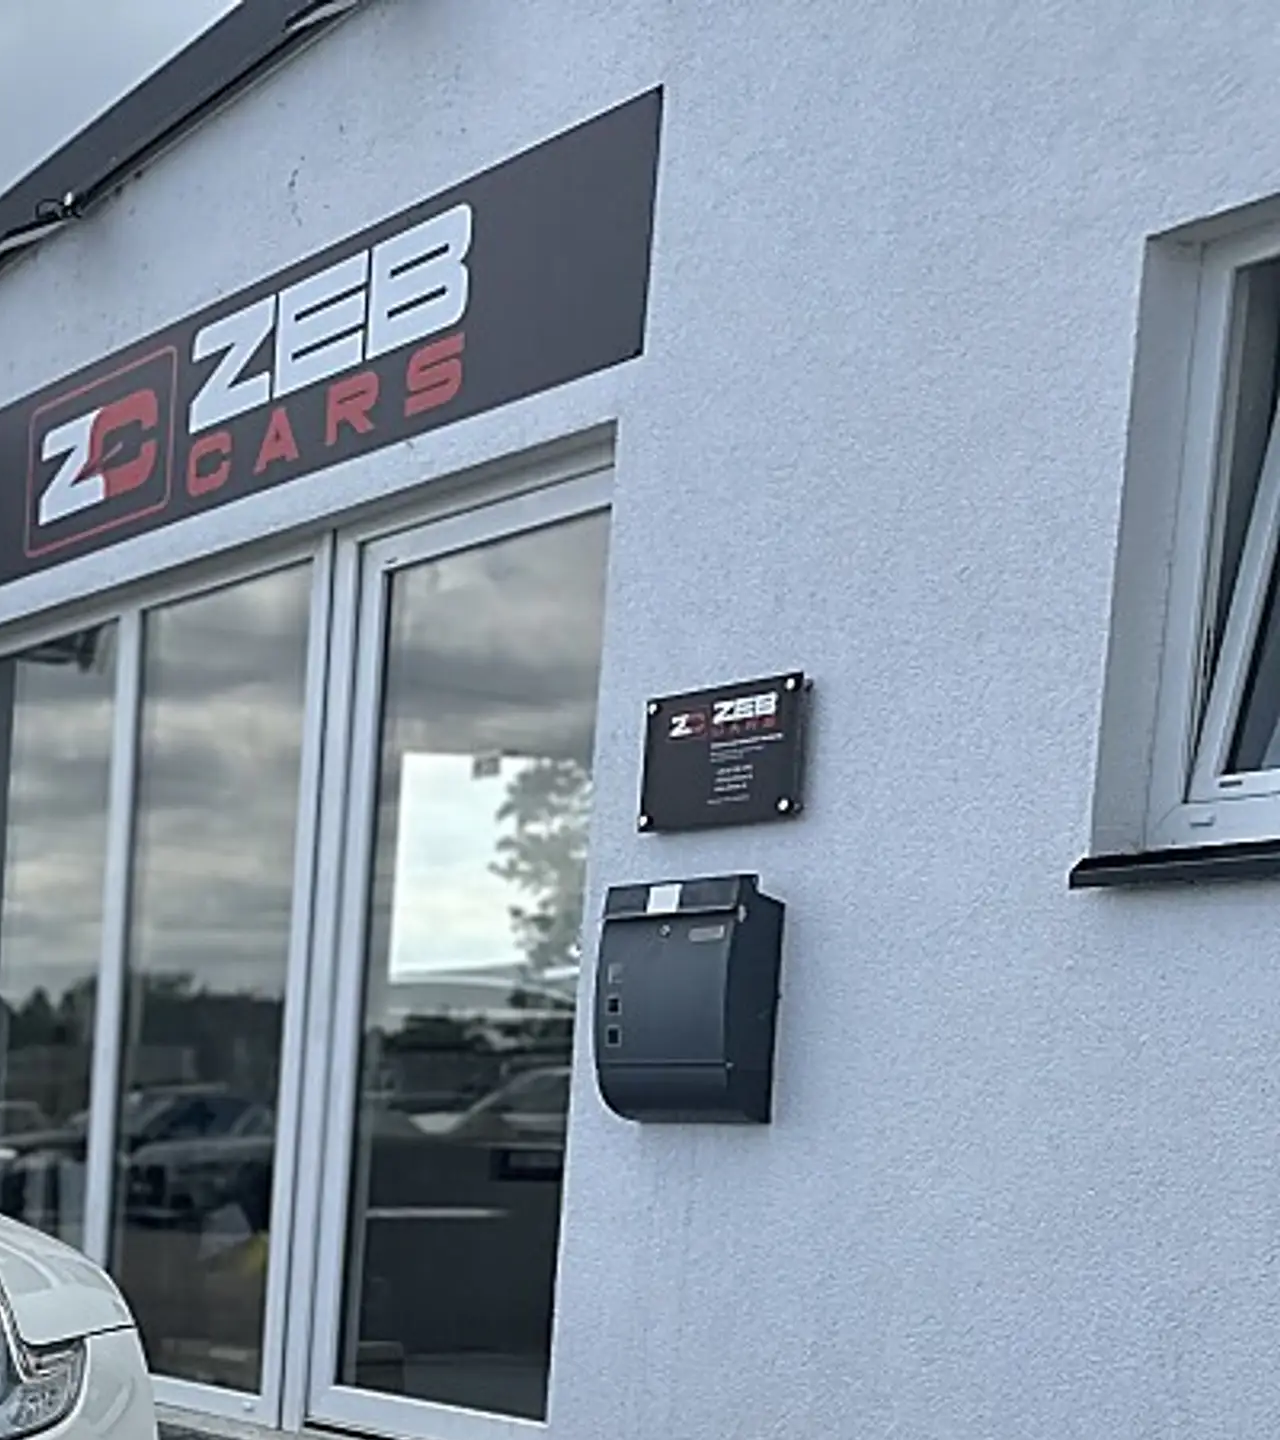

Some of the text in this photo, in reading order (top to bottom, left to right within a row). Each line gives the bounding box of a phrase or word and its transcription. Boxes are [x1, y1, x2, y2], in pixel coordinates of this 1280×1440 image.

[189, 203, 472, 434] ZEB
[187, 333, 466, 497] CARS
[712, 692, 778, 725] ZEB
